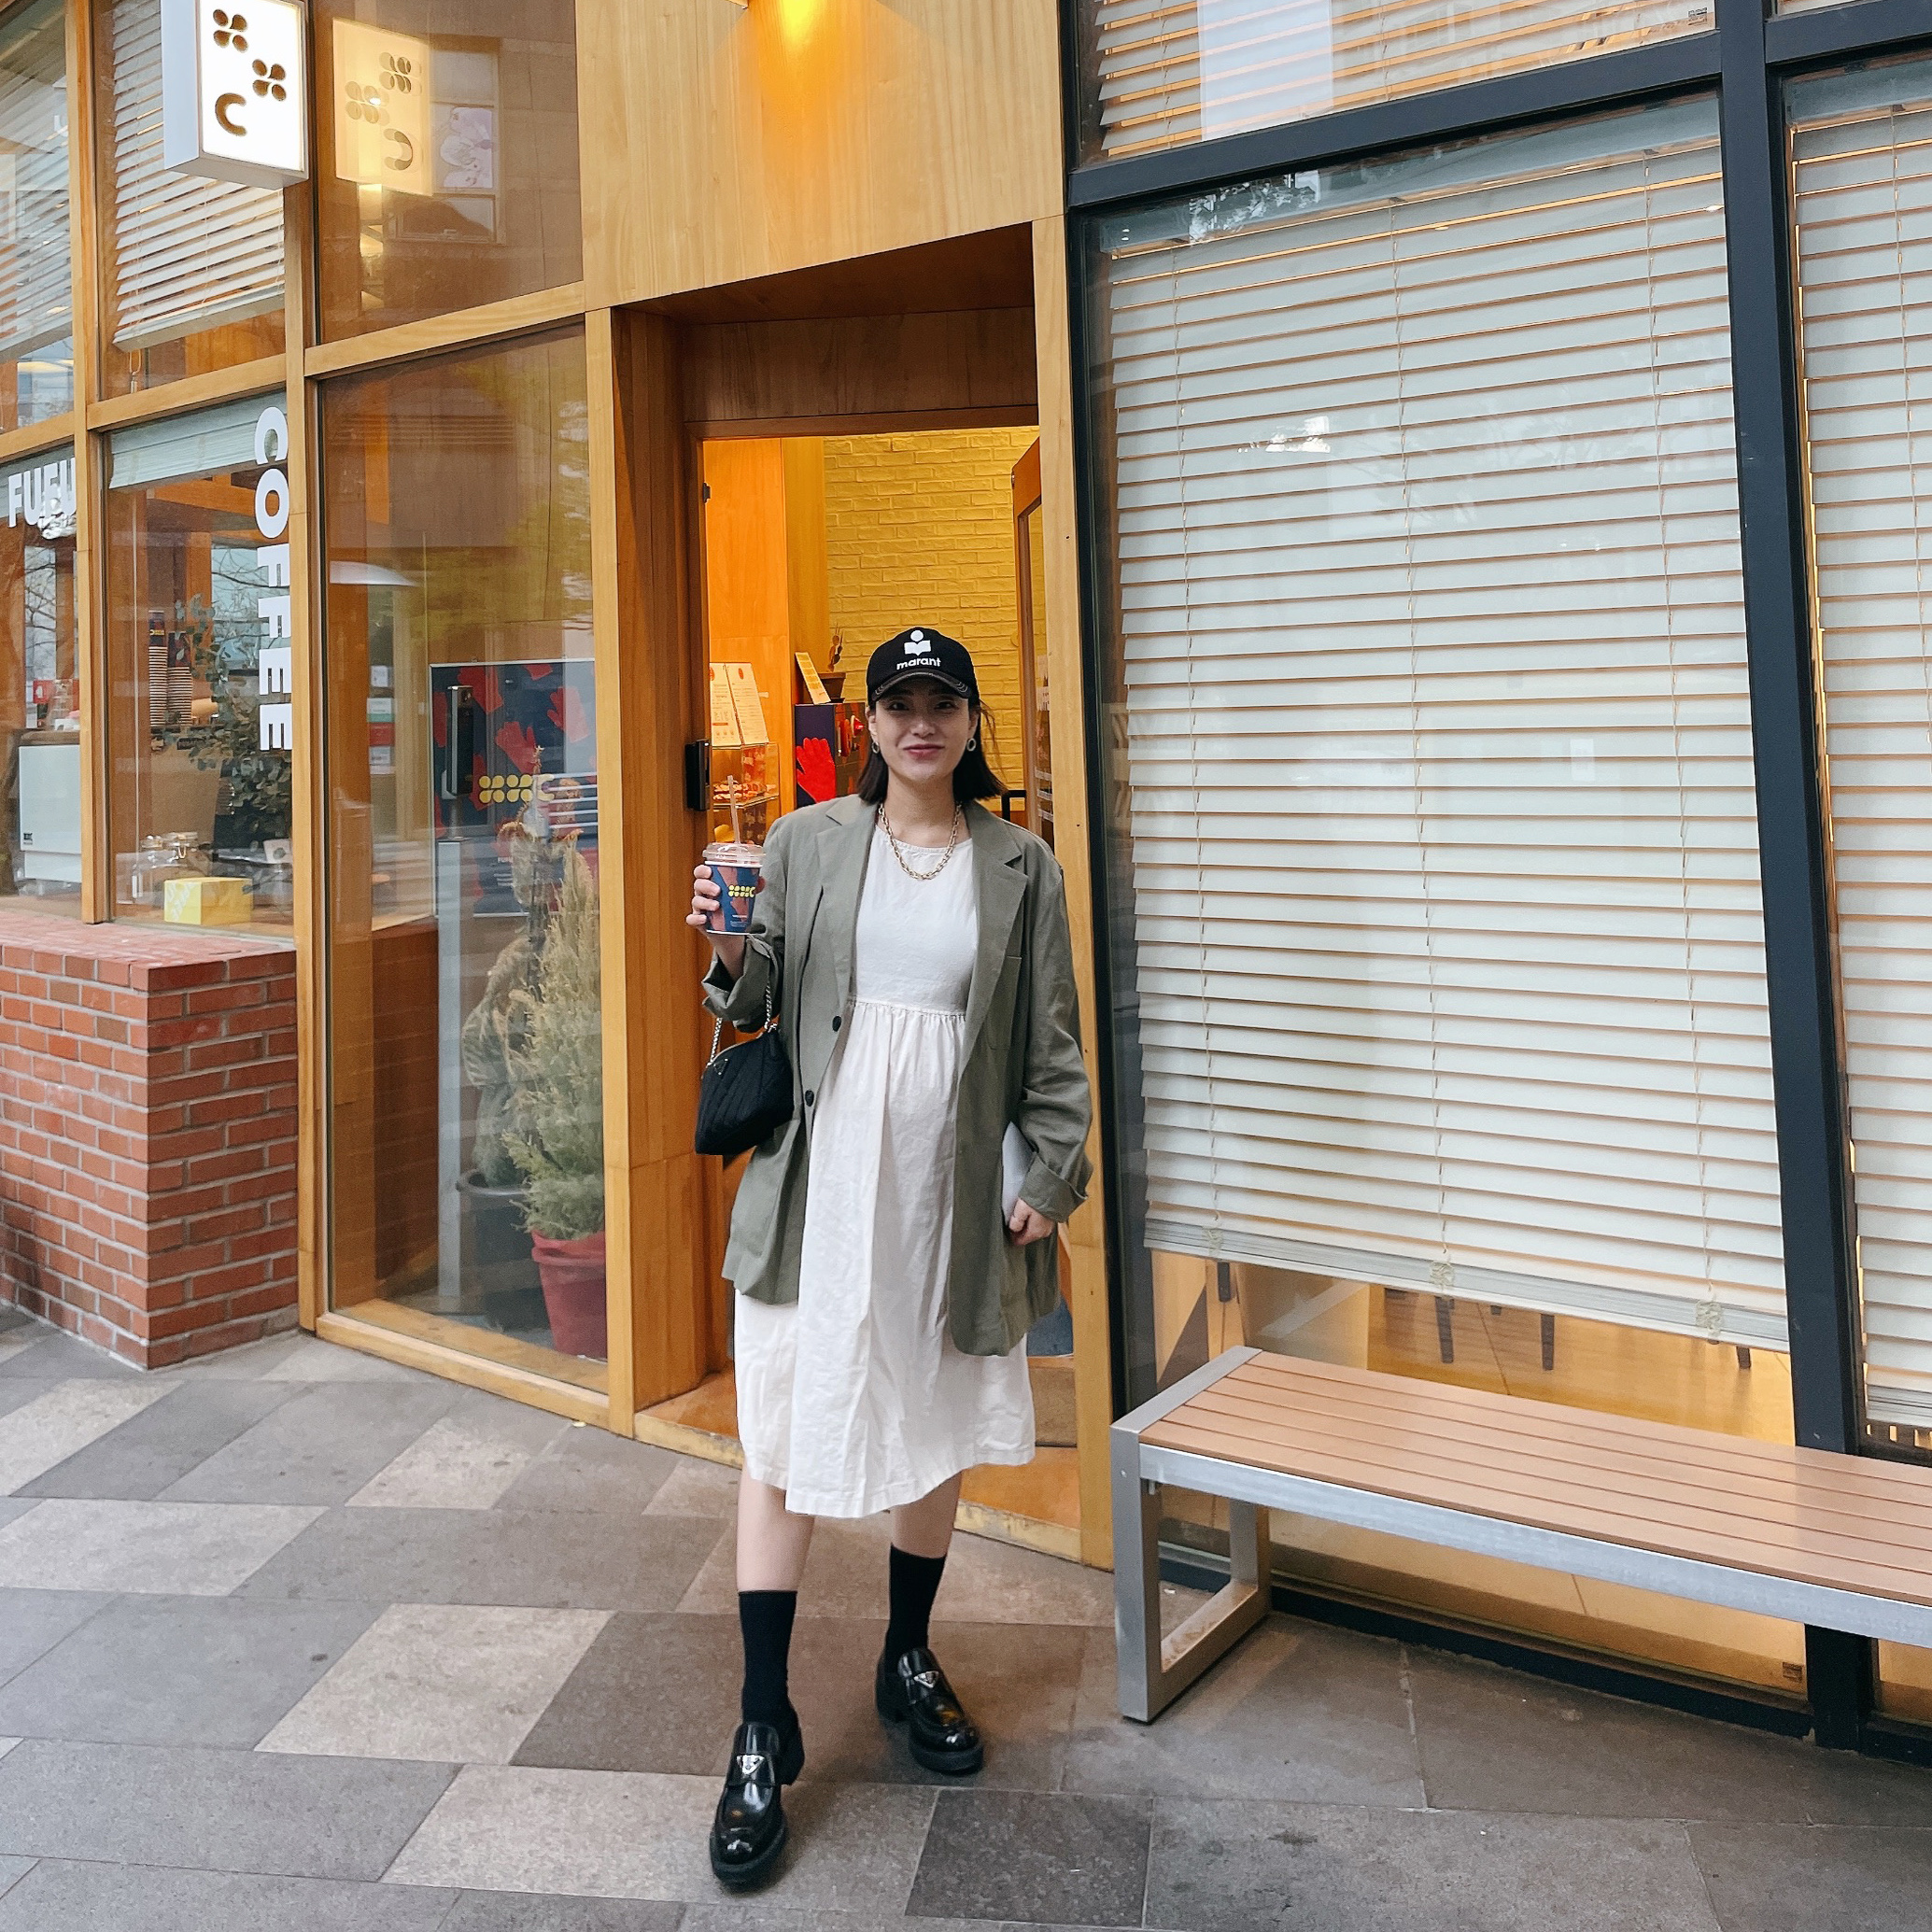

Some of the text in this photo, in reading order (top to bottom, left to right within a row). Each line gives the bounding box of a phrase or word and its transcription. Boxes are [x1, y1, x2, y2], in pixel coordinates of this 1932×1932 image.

[8, 457, 77, 529] FUFU
[255, 406, 292, 751] COFFEE
[896, 656, 941, 670] marant
